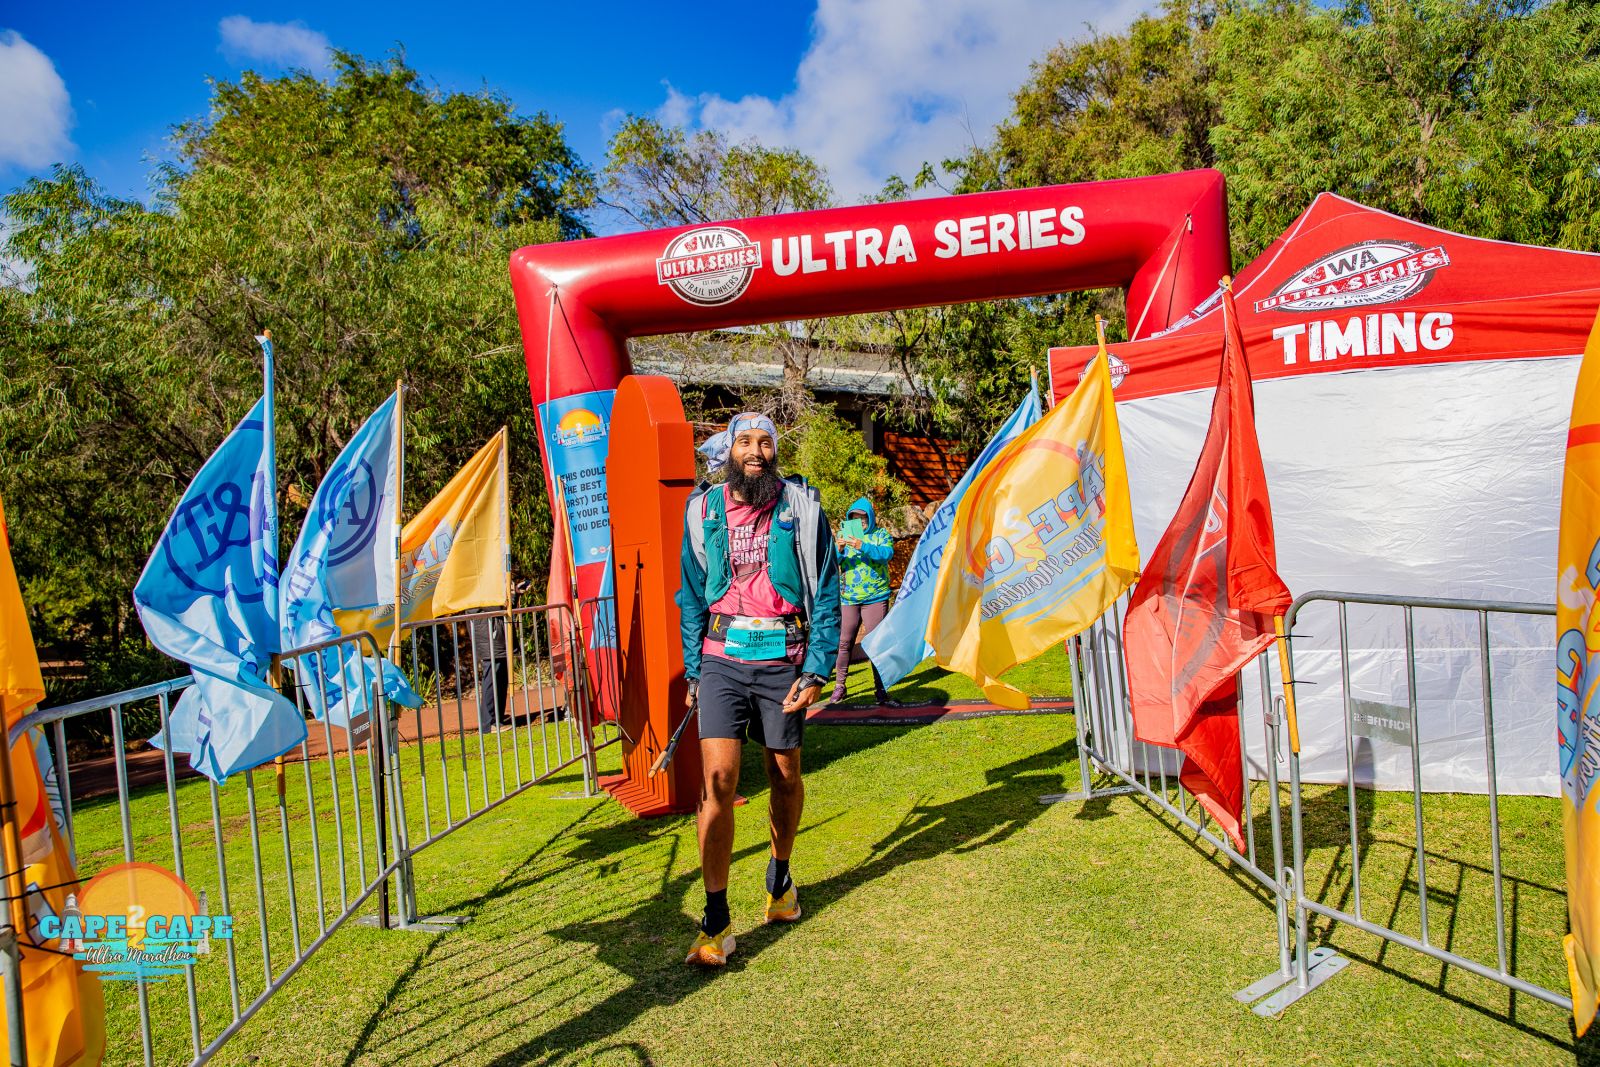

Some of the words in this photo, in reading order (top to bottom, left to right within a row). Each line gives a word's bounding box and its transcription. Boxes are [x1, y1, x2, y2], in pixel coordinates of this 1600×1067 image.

[699, 234, 726, 250] WA
[771, 224, 917, 277] ULTRA
[934, 205, 1086, 259] SERIES
[662, 257, 705, 278] ULTRA
[708, 249, 755, 272] SERIES
[1326, 249, 1379, 276] WA
[684, 280, 705, 296] TRAIL
[708, 275, 739, 297] RUNNERS
[1262, 284, 1339, 309] ULTRA
[1348, 251, 1441, 291] SERIES
[1298, 299, 1335, 308] TRAIL
[1343, 284, 1408, 306] RUNNERS
[1272, 311, 1454, 365] TIMING
[560, 472, 578, 482] THIS
[580, 466, 607, 479] COULD
[564, 485, 578, 496] THE
[580, 480, 602, 492] BEST
[576, 507, 599, 519] YOUR
[573, 522, 588, 534] YOU
[734, 525, 756, 539] THE
[734, 548, 766, 566] SINGH
[747, 631, 765, 642] 136
